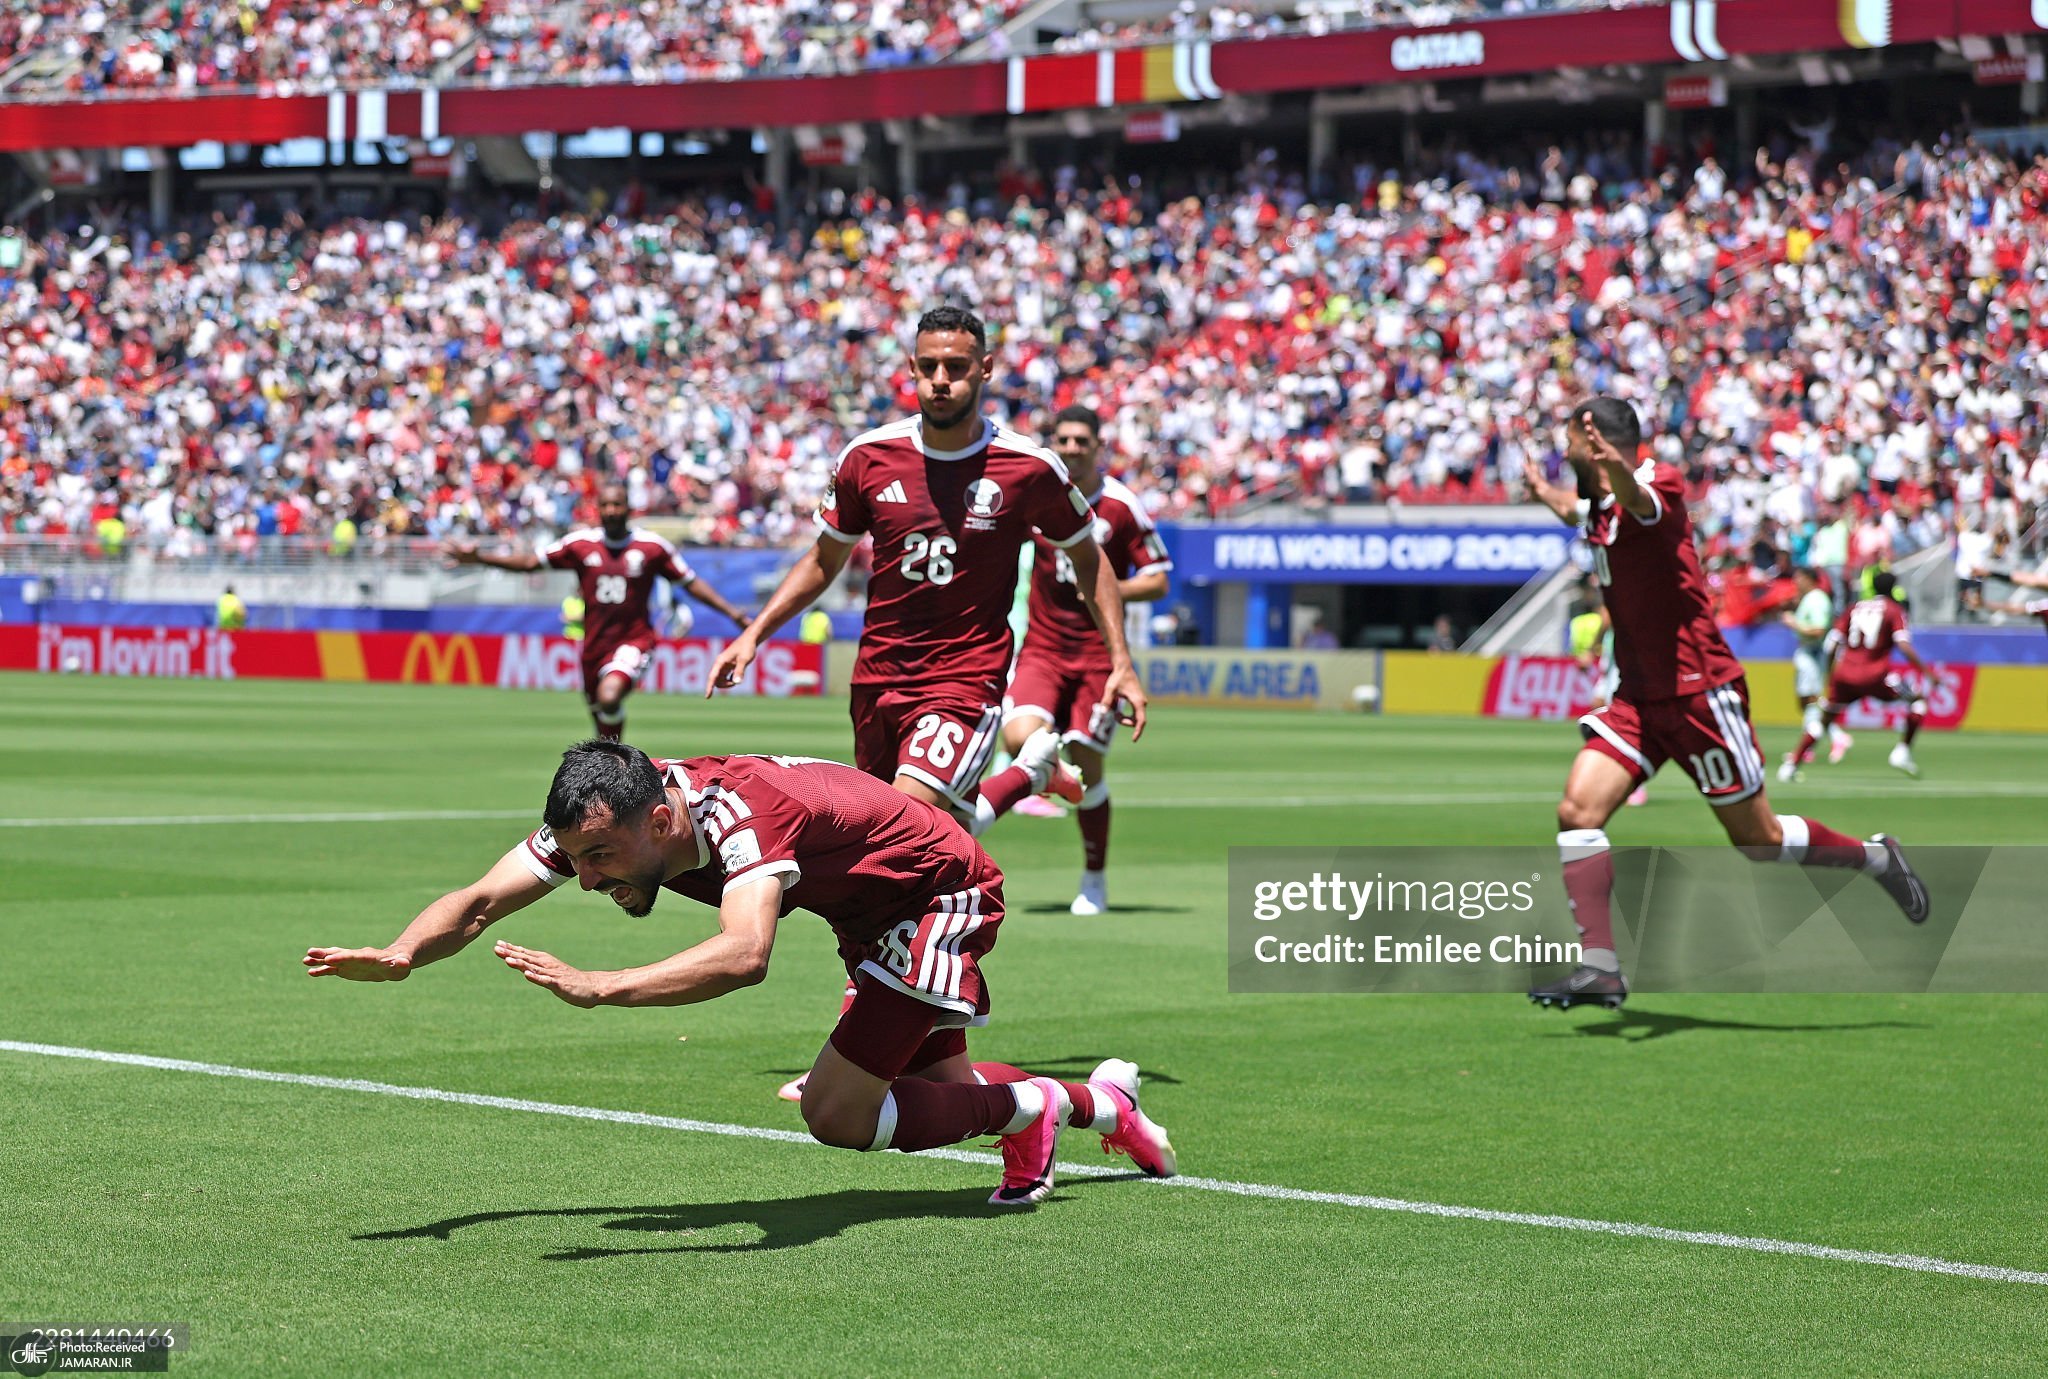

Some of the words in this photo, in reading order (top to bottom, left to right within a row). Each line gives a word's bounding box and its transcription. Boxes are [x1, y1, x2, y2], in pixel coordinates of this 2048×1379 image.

[1391, 30, 1484, 71] QATAR
[901, 533, 957, 586] 26
[1214, 534, 1279, 569] FIFA
[1279, 533, 1390, 570] WORLD
[1390, 533, 1451, 570] CUP
[1451, 532, 1566, 570] 2026
[38, 624, 94, 675] i'm
[101, 625, 199, 677] lovin'
[204, 627, 236, 679] it
[1147, 659, 1217, 697] BAY
[1223, 660, 1320, 698] AREA
[908, 713, 964, 769] 26
[1688, 747, 1734, 791] 10
